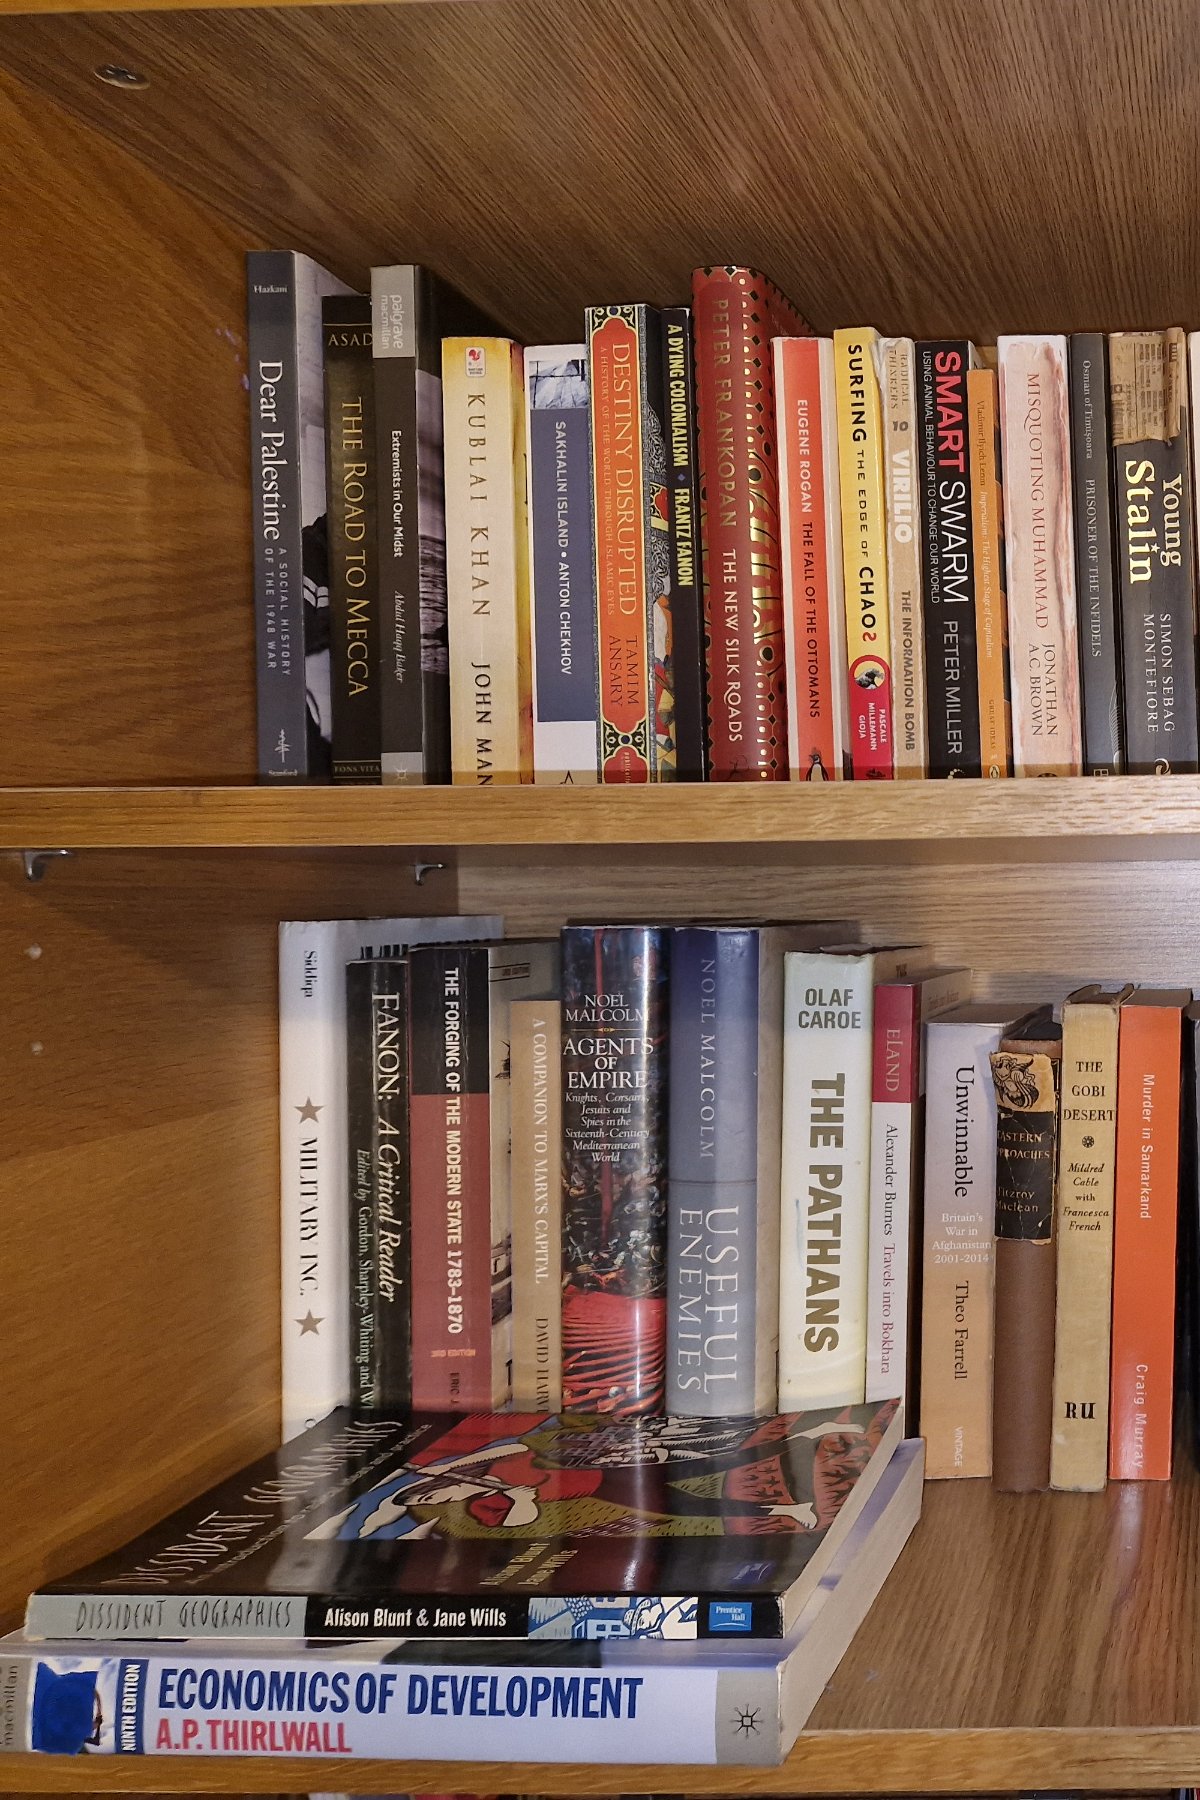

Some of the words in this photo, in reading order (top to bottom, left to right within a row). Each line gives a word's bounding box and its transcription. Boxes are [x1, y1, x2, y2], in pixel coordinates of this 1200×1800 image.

[328, 334, 374, 348] ASAD
[390, 295, 405, 350] palgrave
[259, 360, 284, 424] Dear
[612, 344, 633, 462] DESTINY
[934, 351, 965, 474] SMART
[341, 396, 364, 451] THE
[1024, 373, 1045, 502] MISQUOTING
[555, 421, 568, 493] SAKHALIN
[261, 430, 289, 542] Palestine
[342, 461, 368, 542] ROAD
[556, 496, 571, 550] ISLAND
[614, 468, 638, 617] DISRUPTED
[939, 480, 970, 604] SWARM
[1125, 460, 1161, 585] Stalin
[1160, 473, 1184, 568] Young
[279, 548, 286, 556] A
[345, 550, 368, 590] TO
[1032, 507, 1050, 630] MUHAMMAD
[279, 563, 288, 612] SOCIAL
[559, 562, 571, 608] ANTON
[901, 591, 913, 614] THE
[281, 619, 292, 677] HISTORY
[346, 597, 372, 698] MECCA
[560, 611, 573, 676] CHEKHOV
[902, 618, 915, 704] INFORMATION
[943, 621, 961, 683] PETER
[1160, 613, 1173, 670] SIMON
[608, 635, 624, 707] ANSARY
[626, 635, 640, 706] TAMIM
[1143, 614, 1159, 734] MONTEFIORE
[905, 707, 917, 752] BOMB
[945, 686, 964, 755] MILLER
[1162, 676, 1176, 733] SEBAG
[585, 994, 629, 1008] NOEL
[701, 959, 716, 1024] NOEL
[805, 988, 854, 1008] OLAF
[563, 1038, 654, 1057] AGENTS
[798, 1010, 862, 1030] CAROE
[568, 1072, 648, 1090] EMPIRE
[594, 1057, 619, 1072] OF
[886, 1029, 905, 1093] ELAND
[1076, 1061, 1104, 1074] THE
[700, 1035, 716, 1159] MALCOLM
[810, 1073, 846, 1149] THE
[1063, 1109, 1116, 1122] DESERT
[1071, 1085, 1106, 1097] GOBI
[573, 1141, 641, 1151] Mediterranean
[592, 1152, 621, 1163] World
[954, 1065, 976, 1198] Unwinnable
[300, 1137, 320, 1242] MILITARY
[1067, 1163, 1106, 1174] Mildred
[1073, 1177, 1100, 1188] Cable
[1062, 1208, 1110, 1219] Francesca
[1076, 1194, 1097, 1202] with
[932, 1240, 993, 1251] Afghanistan
[1069, 1222, 1102, 1232] French
[300, 1254, 319, 1296] INC.
[804, 1164, 844, 1354] PATHANS
[678, 1208, 703, 1392] ENEMIES
[704, 1206, 740, 1395] USEFUL
[955, 1281, 970, 1323] Theo
[955, 1328, 969, 1381] Farrell
[76, 1600, 167, 1633] DISSIDENT
[179, 1599, 293, 1630] GEOGRAPHIES
[324, 1610, 369, 1629] Alison
[373, 1609, 413, 1628] Blunt
[416, 1610, 429, 1627] &
[434, 1610, 467, 1628] Jane
[469, 1608, 508, 1628] Wills
[158, 1668, 351, 1714] ECONOMICS
[355, 1672, 398, 1715] OF
[407, 1675, 644, 1720] DEVELOPMENT
